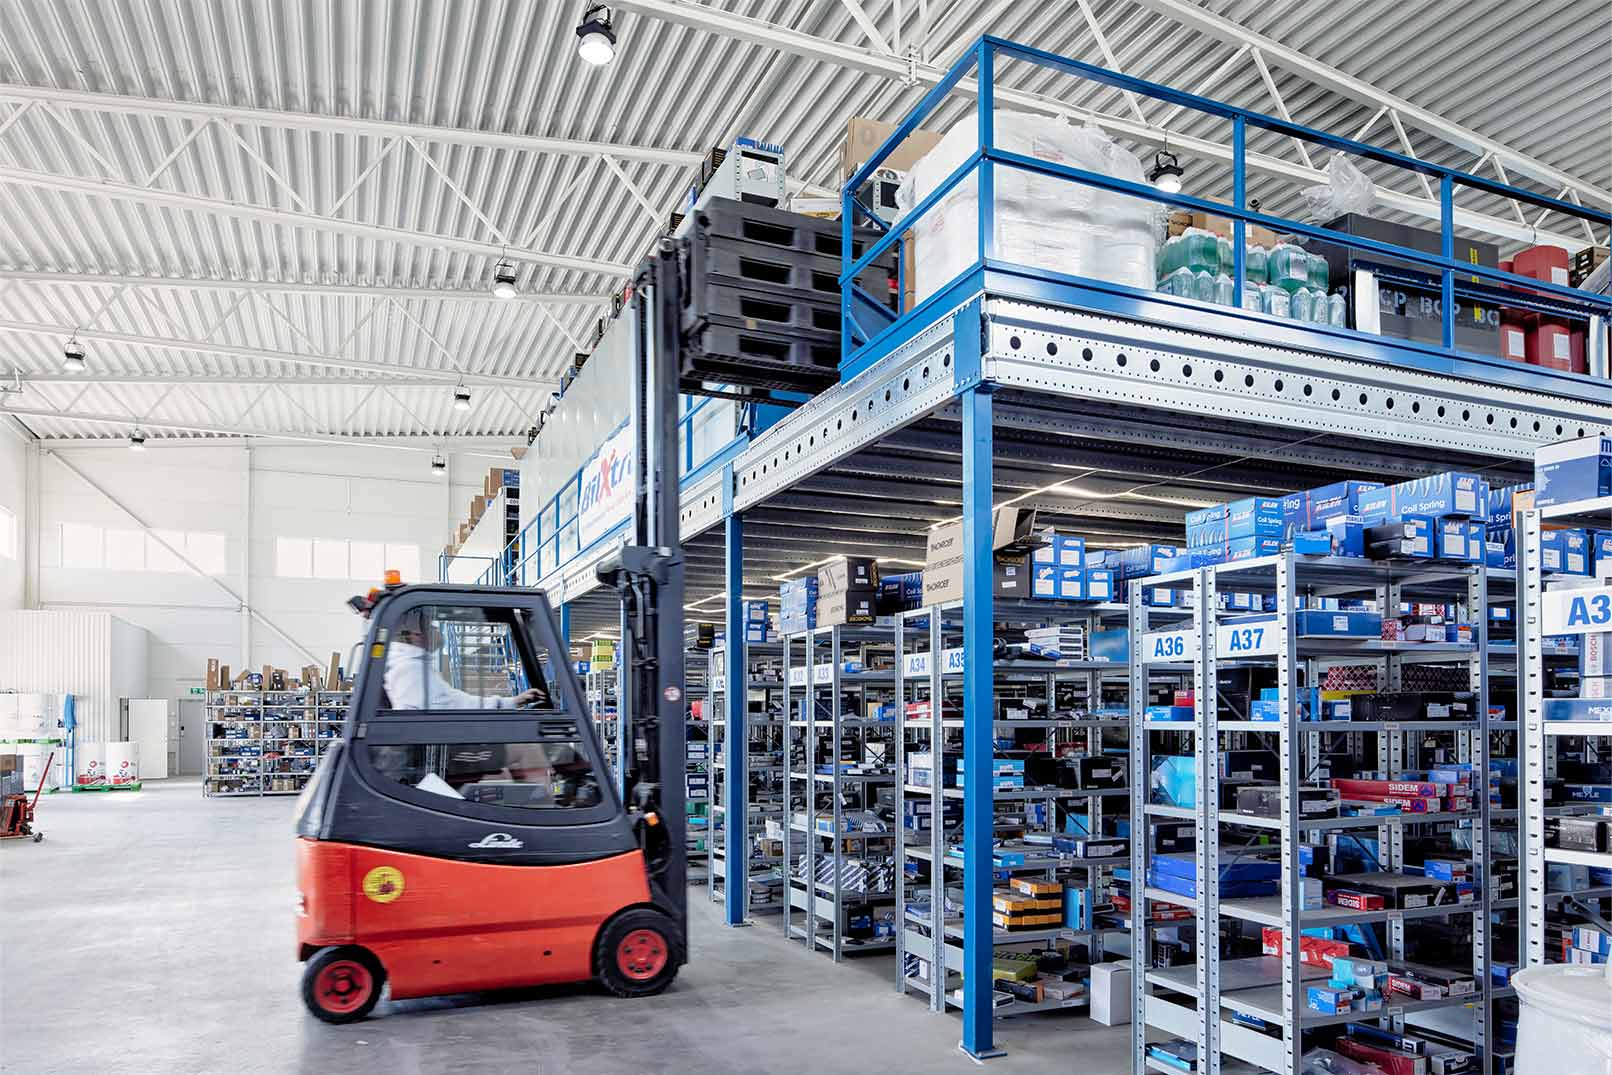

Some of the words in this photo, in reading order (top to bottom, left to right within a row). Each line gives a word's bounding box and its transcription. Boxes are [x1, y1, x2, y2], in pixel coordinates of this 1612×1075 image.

[1401, 506, 1418, 514] Coil
[1419, 500, 1445, 511] Spring
[1154, 636, 1184, 657] A36
[1229, 628, 1264, 651] A37
[910, 657, 925, 672] A34
[1388, 783, 1418, 792] SIDEM
[1337, 896, 1360, 909] SIDEM
